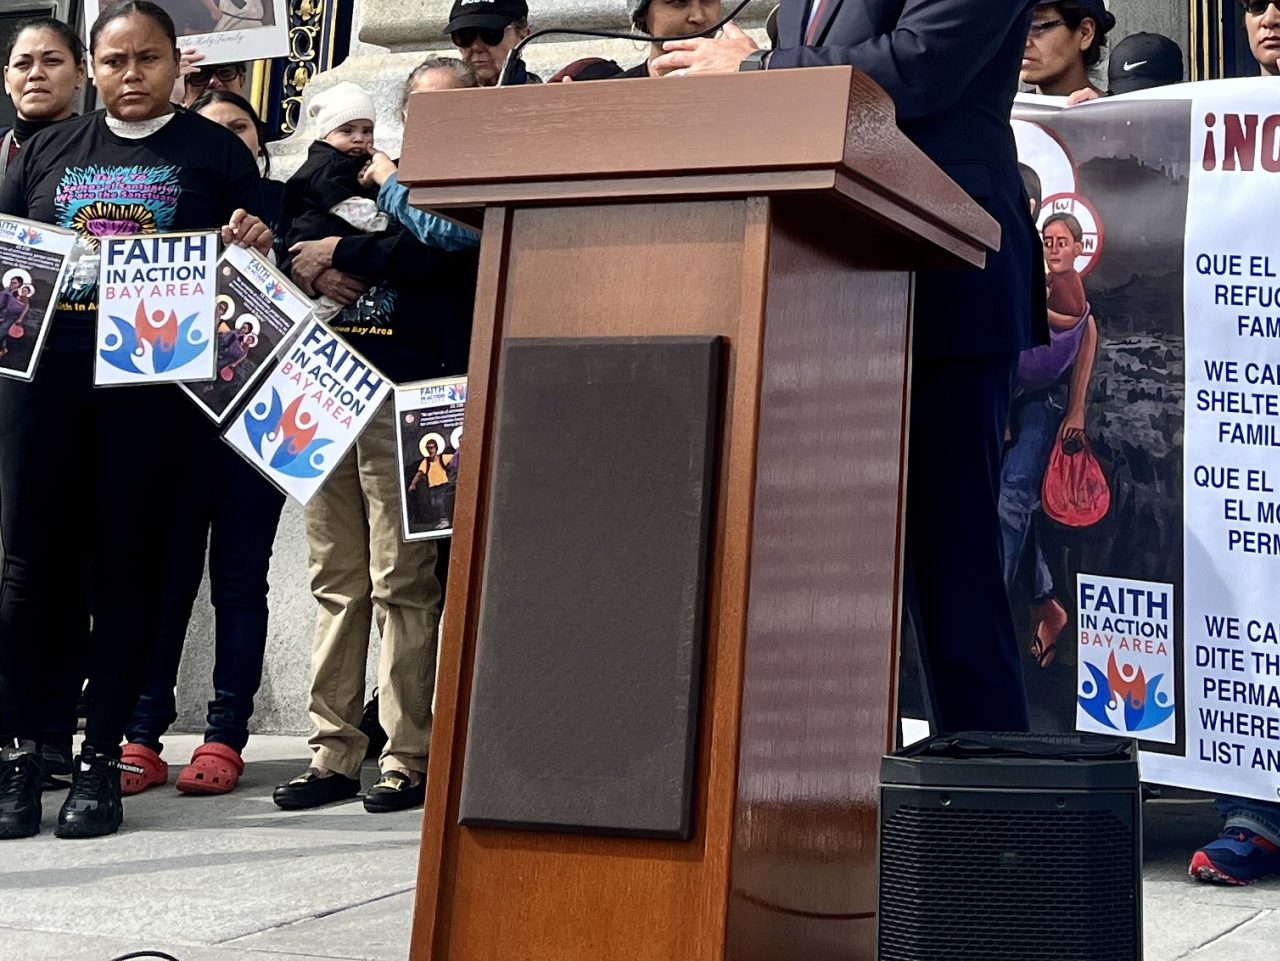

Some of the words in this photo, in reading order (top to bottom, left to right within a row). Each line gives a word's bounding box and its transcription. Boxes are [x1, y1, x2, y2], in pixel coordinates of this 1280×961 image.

[108, 236, 206, 265] FAITH
[107, 269, 126, 284] IN
[131, 265, 206, 282] ACTION
[249, 259, 271, 279] FAITH
[1195, 253, 1242, 276] QUE
[1249, 255, 1277, 278] EL
[106, 285, 144, 299] BAY
[149, 282, 204, 297] AREA
[351, 326, 368, 335] Bay
[369, 325, 393, 335] Area
[302, 323, 384, 401] FAITH
[1203, 359, 1239, 383] WE
[291, 348, 311, 369] IN
[308, 365, 366, 416] ACTION
[421, 386, 445, 395] FAITH
[281, 362, 313, 391] BAY
[311, 390, 352, 429] AREA
[1193, 464, 1240, 490] QUE
[1246, 469, 1274, 493] EL
[1080, 583, 1167, 620] FAITH
[1081, 614, 1097, 630] IN
[1102, 617, 1168, 639] ACTION
[1204, 614, 1241, 641] WE
[1081, 632, 1113, 648] BAY
[1119, 637, 1167, 656] AREA
[1195, 644, 1245, 673] DITE
[1199, 738, 1246, 767] LIST
